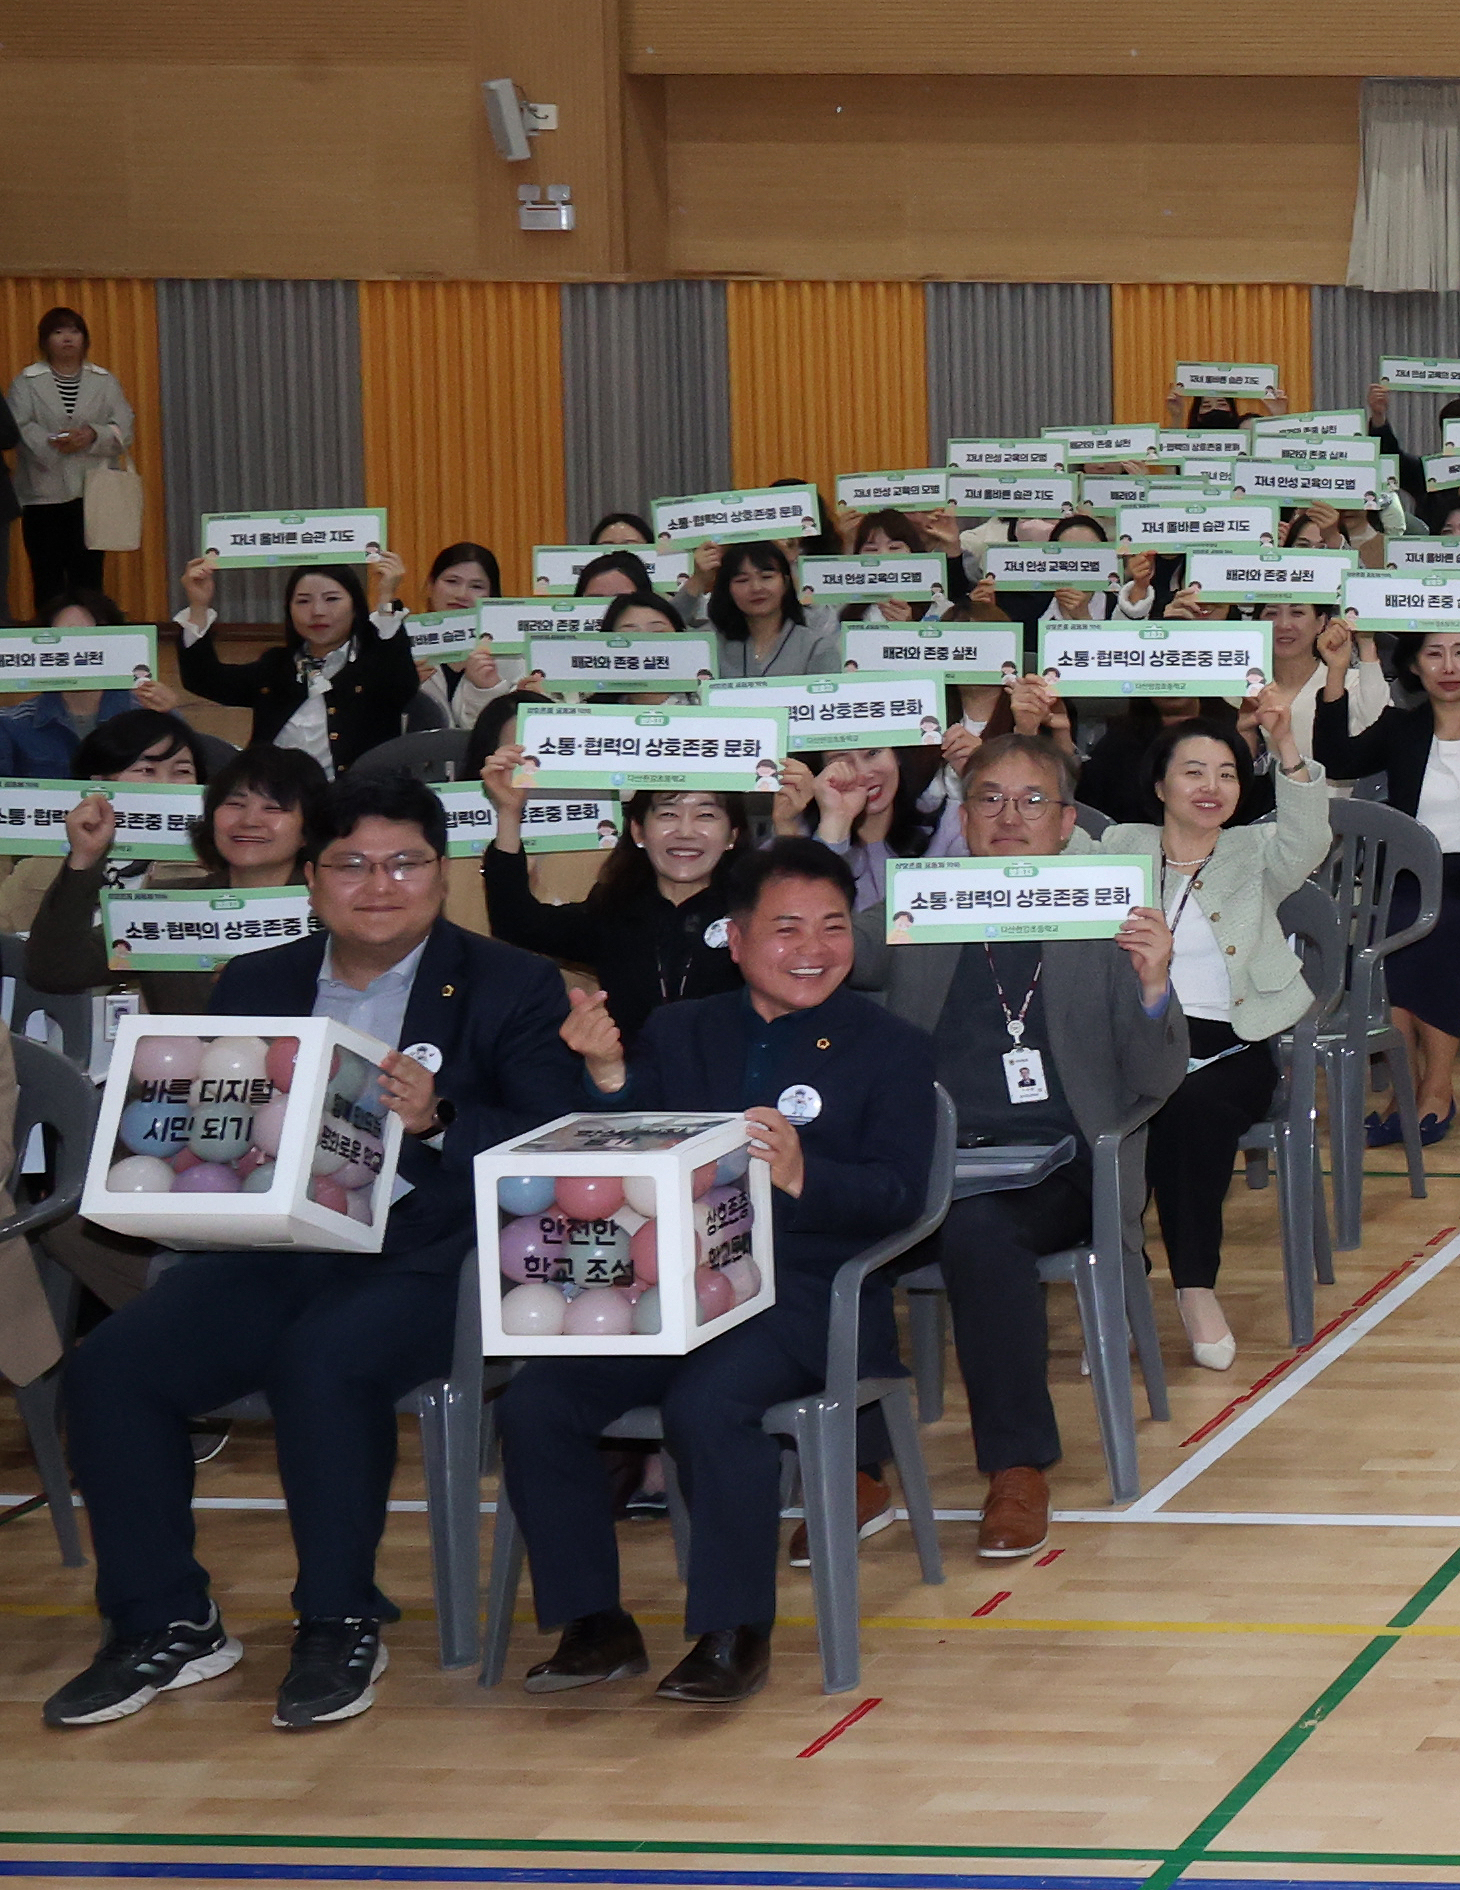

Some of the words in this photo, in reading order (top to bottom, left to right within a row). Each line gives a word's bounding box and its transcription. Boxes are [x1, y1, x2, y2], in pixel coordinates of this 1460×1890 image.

[1255, 475, 1275, 488] 자녀
[1278, 476, 1298, 489] 인성
[1301, 477, 1331, 490] 교육의
[1335, 478, 1355, 490] 모범
[1142, 522, 1163, 534] 자녀
[1167, 520, 1199, 534] 올바른
[1203, 520, 1225, 533] 습관
[1228, 520, 1249, 532] 지도
[231, 533, 256, 546] 자녀
[260, 531, 297, 546] 올바른
[302, 531, 326, 544] 습관
[330, 529, 353, 543] 지도
[1226, 569, 1261, 582] 배려와
[1265, 569, 1287, 582] 존중
[1291, 569, 1313, 583] 실천
[1386, 594, 1424, 608] 배려와
[1428, 595, 1453, 609] 존중
[572, 655, 611, 669] 배려와
[614, 656, 639, 670] 존중
[644, 656, 669, 670] 실천
[1058, 650, 1144, 669] 소통·협력의
[1150, 649, 1212, 668] 상호존중
[1218, 650, 1249, 667] 문화
[538, 737, 640, 759] 소통·협력의
[646, 737, 718, 758] 상호존중
[725, 739, 761, 758] 문화
[911, 889, 1010, 911] 소통·협력의
[1017, 888, 1089, 908] 상호존중
[1095, 886, 1133, 913] 문화
[142, 1079, 194, 1104] 바른
[198, 1079, 274, 1104] 디지털
[144, 1115, 194, 1145] 시민
[200, 1115, 253, 1145] 되기
[539, 1217, 618, 1245] 안전한
[523, 1254, 573, 1286] 학교
[585, 1254, 635, 1286] 조성
